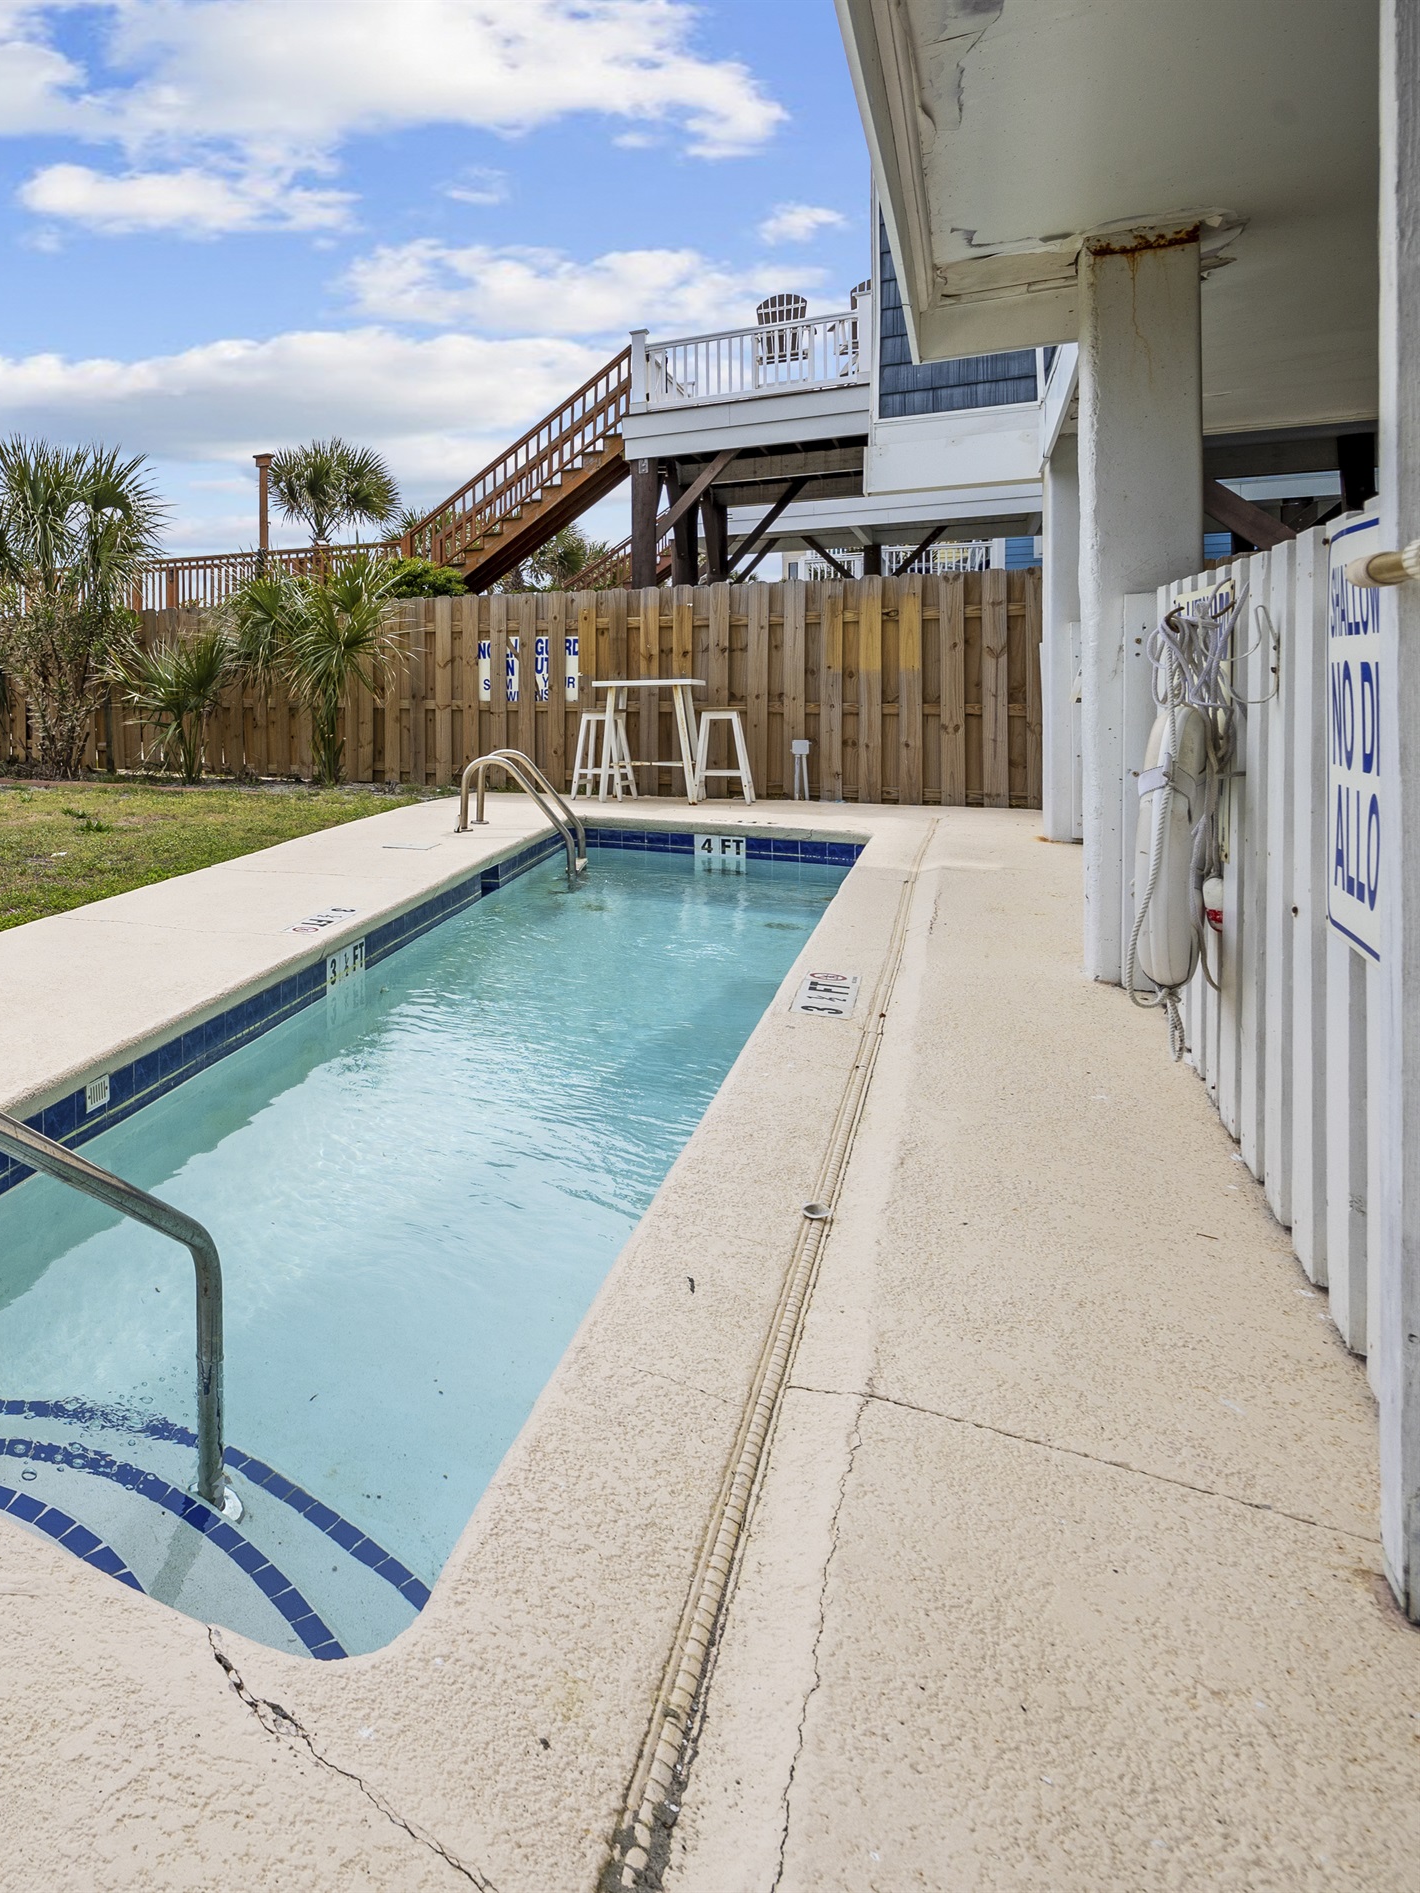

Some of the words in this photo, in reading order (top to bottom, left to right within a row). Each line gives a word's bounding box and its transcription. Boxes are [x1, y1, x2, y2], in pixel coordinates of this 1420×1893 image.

[1331, 660, 1354, 771] NO
[1360, 661, 1380, 776] DI
[701, 838, 713, 853] 4
[721, 838, 744, 856] FT
[1334, 784, 1380, 911] ALLO
[301, 918, 334, 926] FT
[330, 958, 337, 985] 3
[353, 942, 364, 971] FT
[808, 981, 850, 995] FT
[801, 1006, 843, 1014] 3
